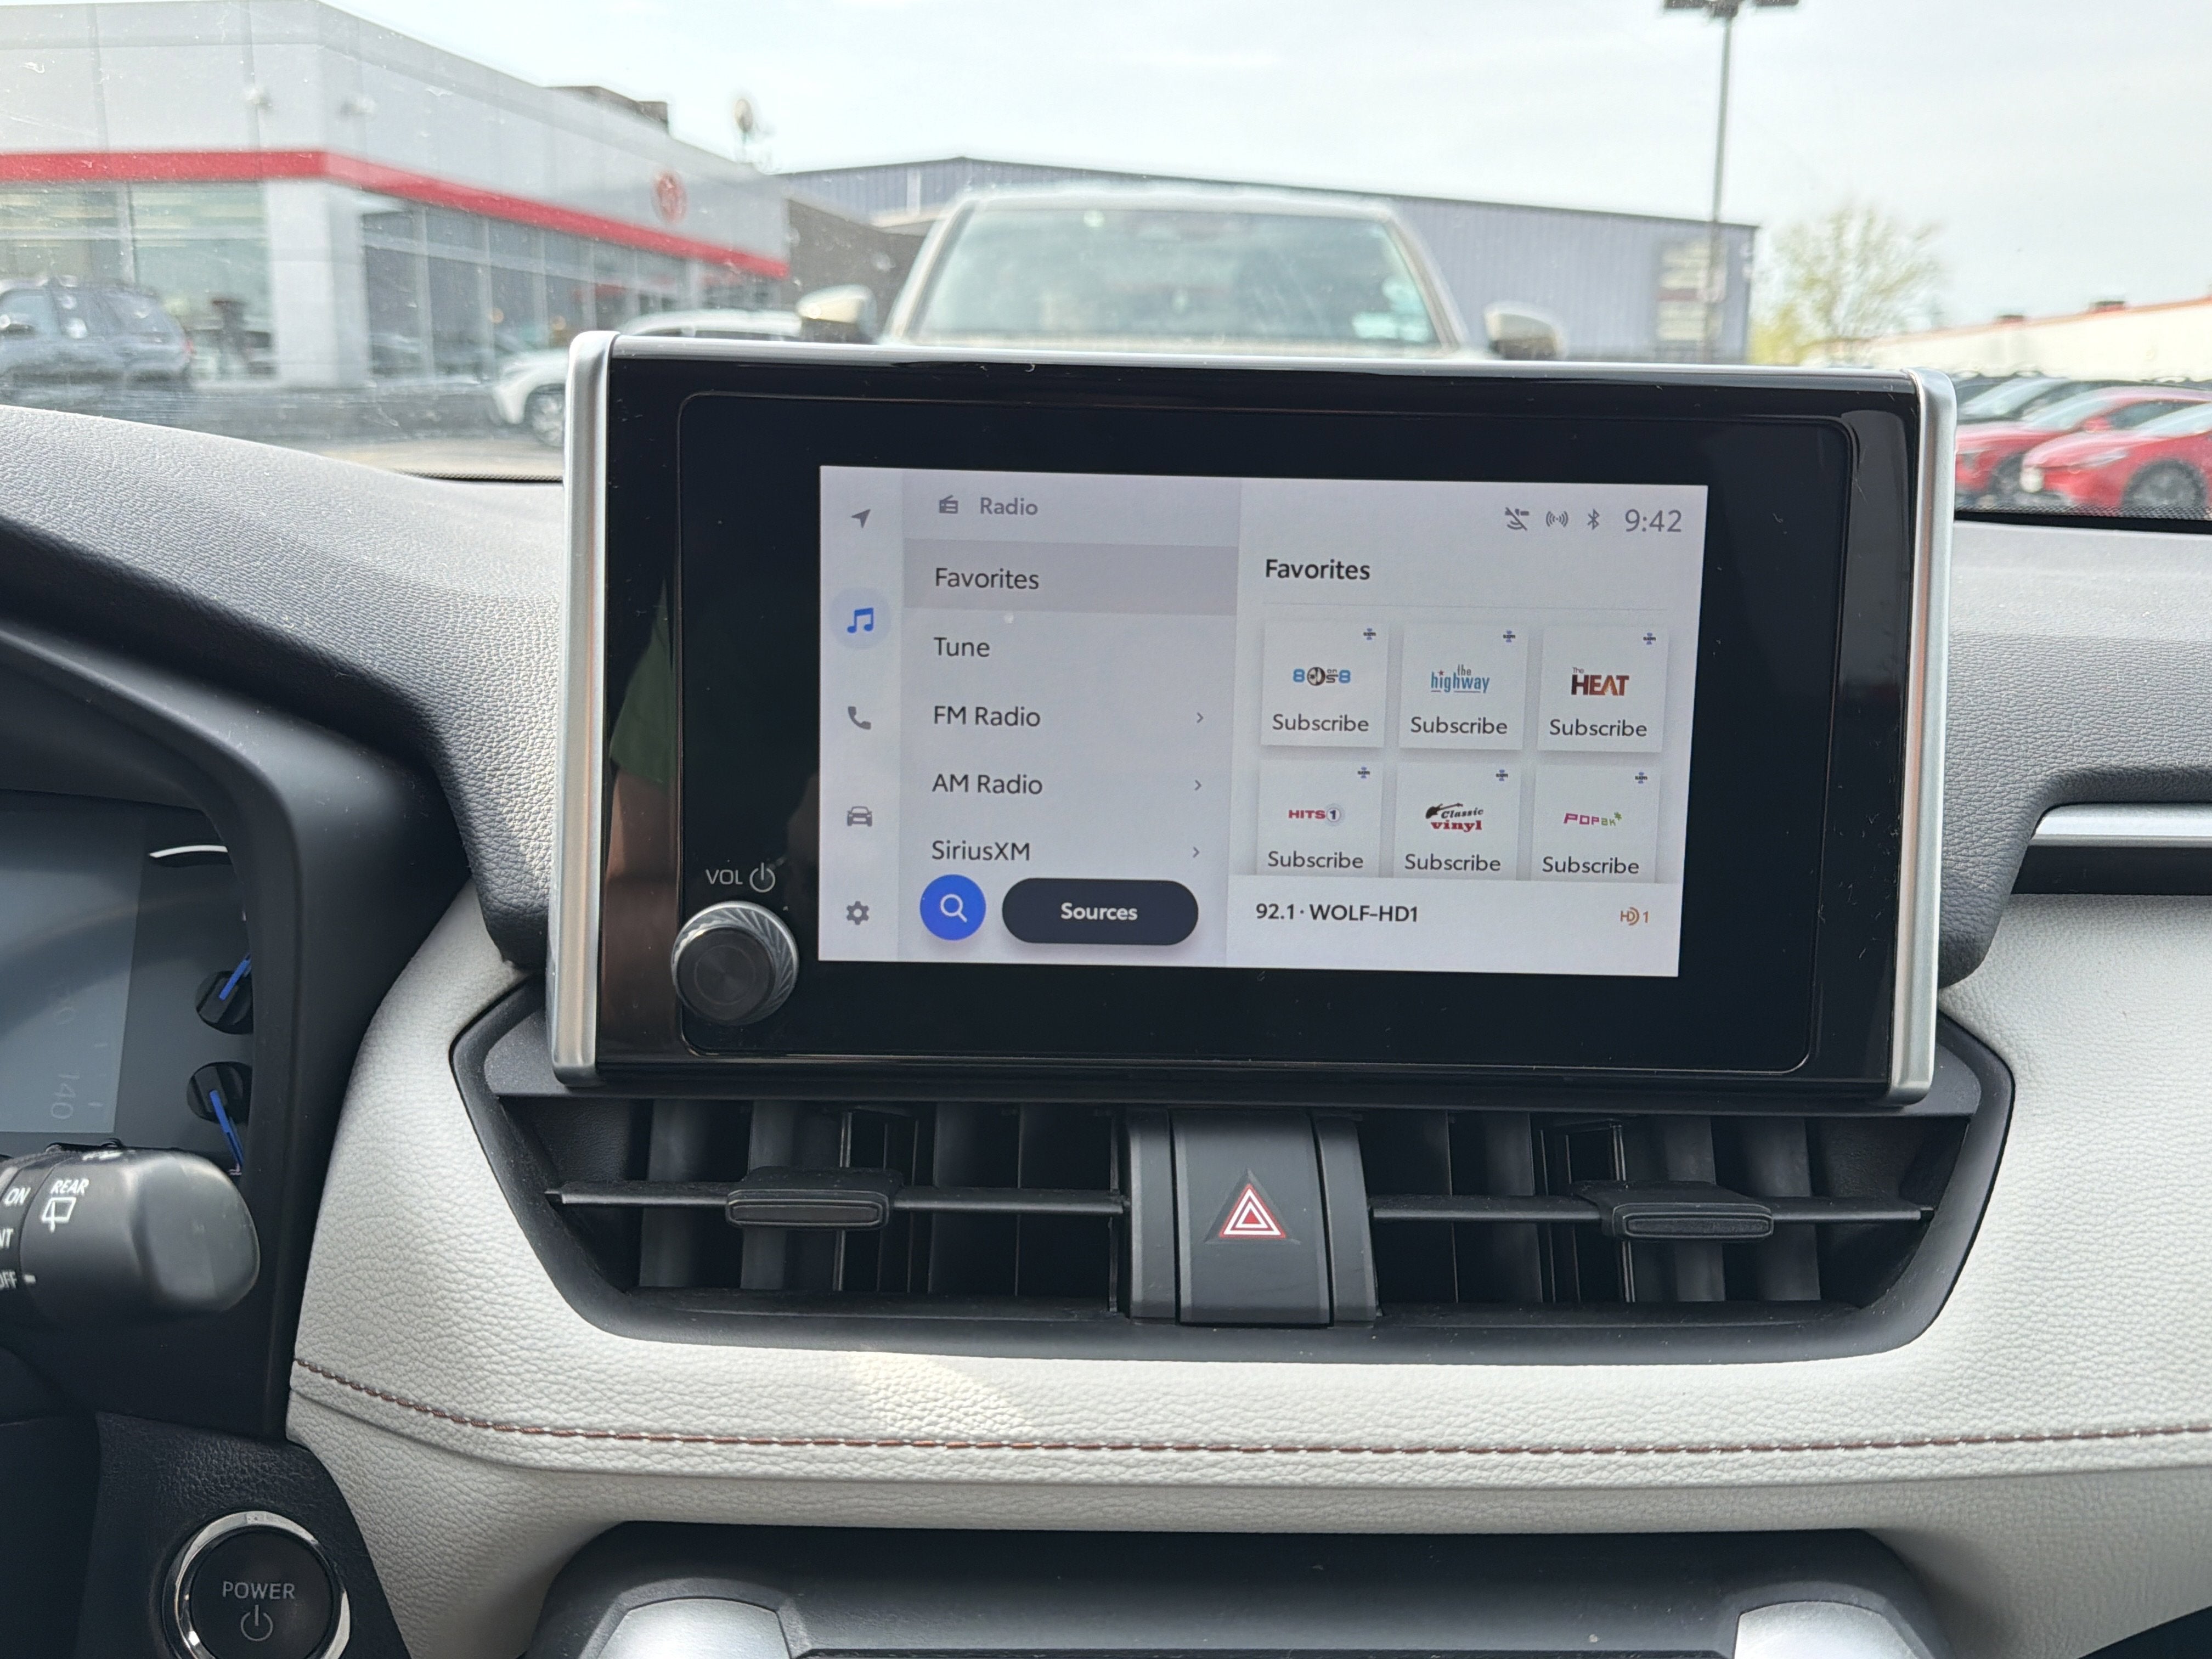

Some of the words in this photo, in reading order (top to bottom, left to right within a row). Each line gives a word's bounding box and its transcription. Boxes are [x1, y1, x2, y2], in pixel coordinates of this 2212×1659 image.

[980, 496, 1038, 516] Radio
[1625, 509, 1682, 533] 9:42
[935, 567, 1039, 590] Favorites
[1265, 558, 1370, 580] Favorites
[934, 636, 990, 658] Tune
[1457, 664, 1471, 676] the
[1430, 671, 1490, 693] highway
[1571, 674, 1629, 696] HEAT
[934, 706, 966, 725] FM
[975, 706, 1041, 727] Radio
[1272, 713, 1369, 732] Subscribe
[1410, 716, 1508, 735] Subscribe
[1549, 718, 1647, 737] Subscribe
[932, 774, 969, 793] AM
[977, 774, 1042, 795] Radio
[1441, 808, 1483, 819] Classic
[1431, 820, 1482, 833] vinyl
[932, 839, 1030, 861] SiriusXM
[1268, 850, 1364, 869] Subscribe
[1404, 853, 1502, 871] Subscribe
[1542, 856, 1640, 874] Subscribe
[706, 869, 743, 885] VOL
[1060, 902, 1138, 921] Sources
[1309, 904, 1418, 922] WOLF-HD1
[50, 1178, 90, 1195] REAR
[3, 1187, 31, 1206] ON
[222, 1581, 295, 1600] POWER
